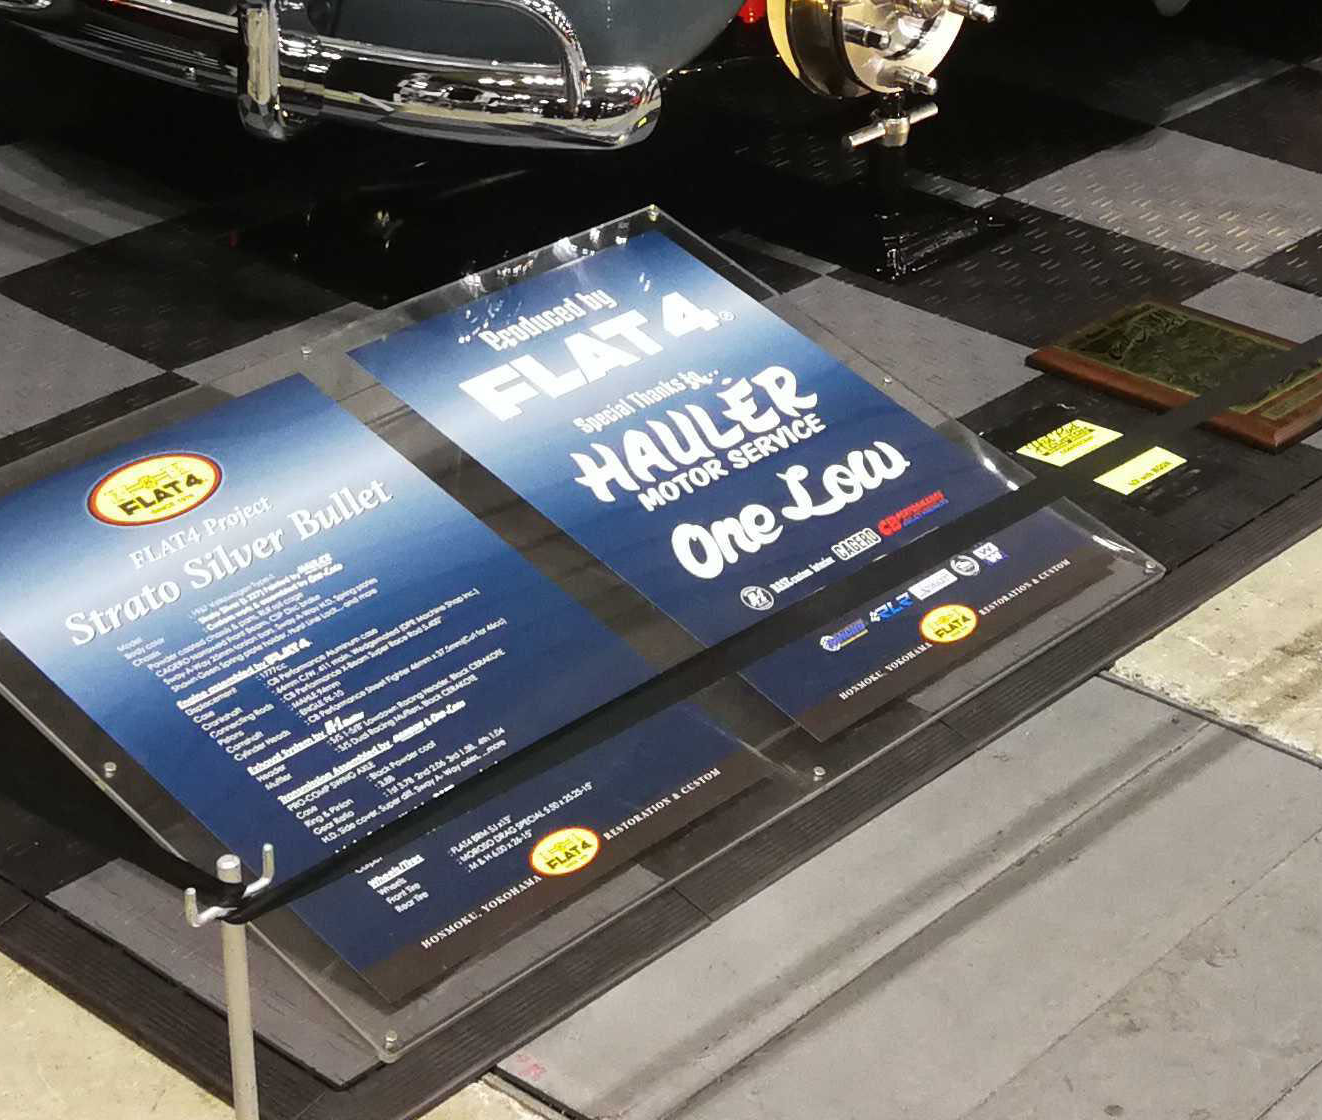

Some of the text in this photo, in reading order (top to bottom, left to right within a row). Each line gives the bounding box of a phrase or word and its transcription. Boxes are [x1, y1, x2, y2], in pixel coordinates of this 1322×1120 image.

[477, 289, 617, 351] Produced by
[569, 362, 817, 502] HAULER
[572, 397, 635, 433] Special
[625, 377, 686, 408] Thanks
[637, 413, 826, 511] MOTOR SERVICE
[129, 495, 274, 570] FLAT4 Project
[671, 440, 910, 578] One Low
[834, 530, 879, 558] CAGERO
[63, 579, 181, 647] Strato
[186, 530, 285, 590] Silver
[279, 477, 393, 544] Bullet
[885, 642, 933, 673] YOKOHAMA
[979, 582, 1030, 616] RESTORATION
[1039, 559, 1071, 581] CUSTOM
[184, 662, 287, 716] Displacement 1777cc
[192, 710, 215, 723] Case
[277, 654, 326, 680] Performance
[325, 636, 360, 657] Aluminum
[359, 628, 378, 639] case
[252, 703, 274, 715] Rods
[294, 668, 342, 695] Performance
[233, 741, 266, 761] Cylinder
[264, 729, 291, 744] Heads
[318, 690, 366, 717] Performance
[255, 764, 285, 782] Header
[396, 691, 424, 708] Racing
[332, 745, 383, 777] Assembled
[366, 718, 396, 735] Racing
[295, 805, 318, 819] Case
[388, 750, 418, 768] Powder
[417, 739, 436, 753] coat
[303, 815, 324, 827] Ring
[312, 821, 334, 835] Gear
[421, 910, 483, 950] HONMOKU,
[481, 874, 543, 912] YOKOHAMA
[603, 797, 672, 840] RESTORATION
[680, 768, 721, 794] CUSTOM
